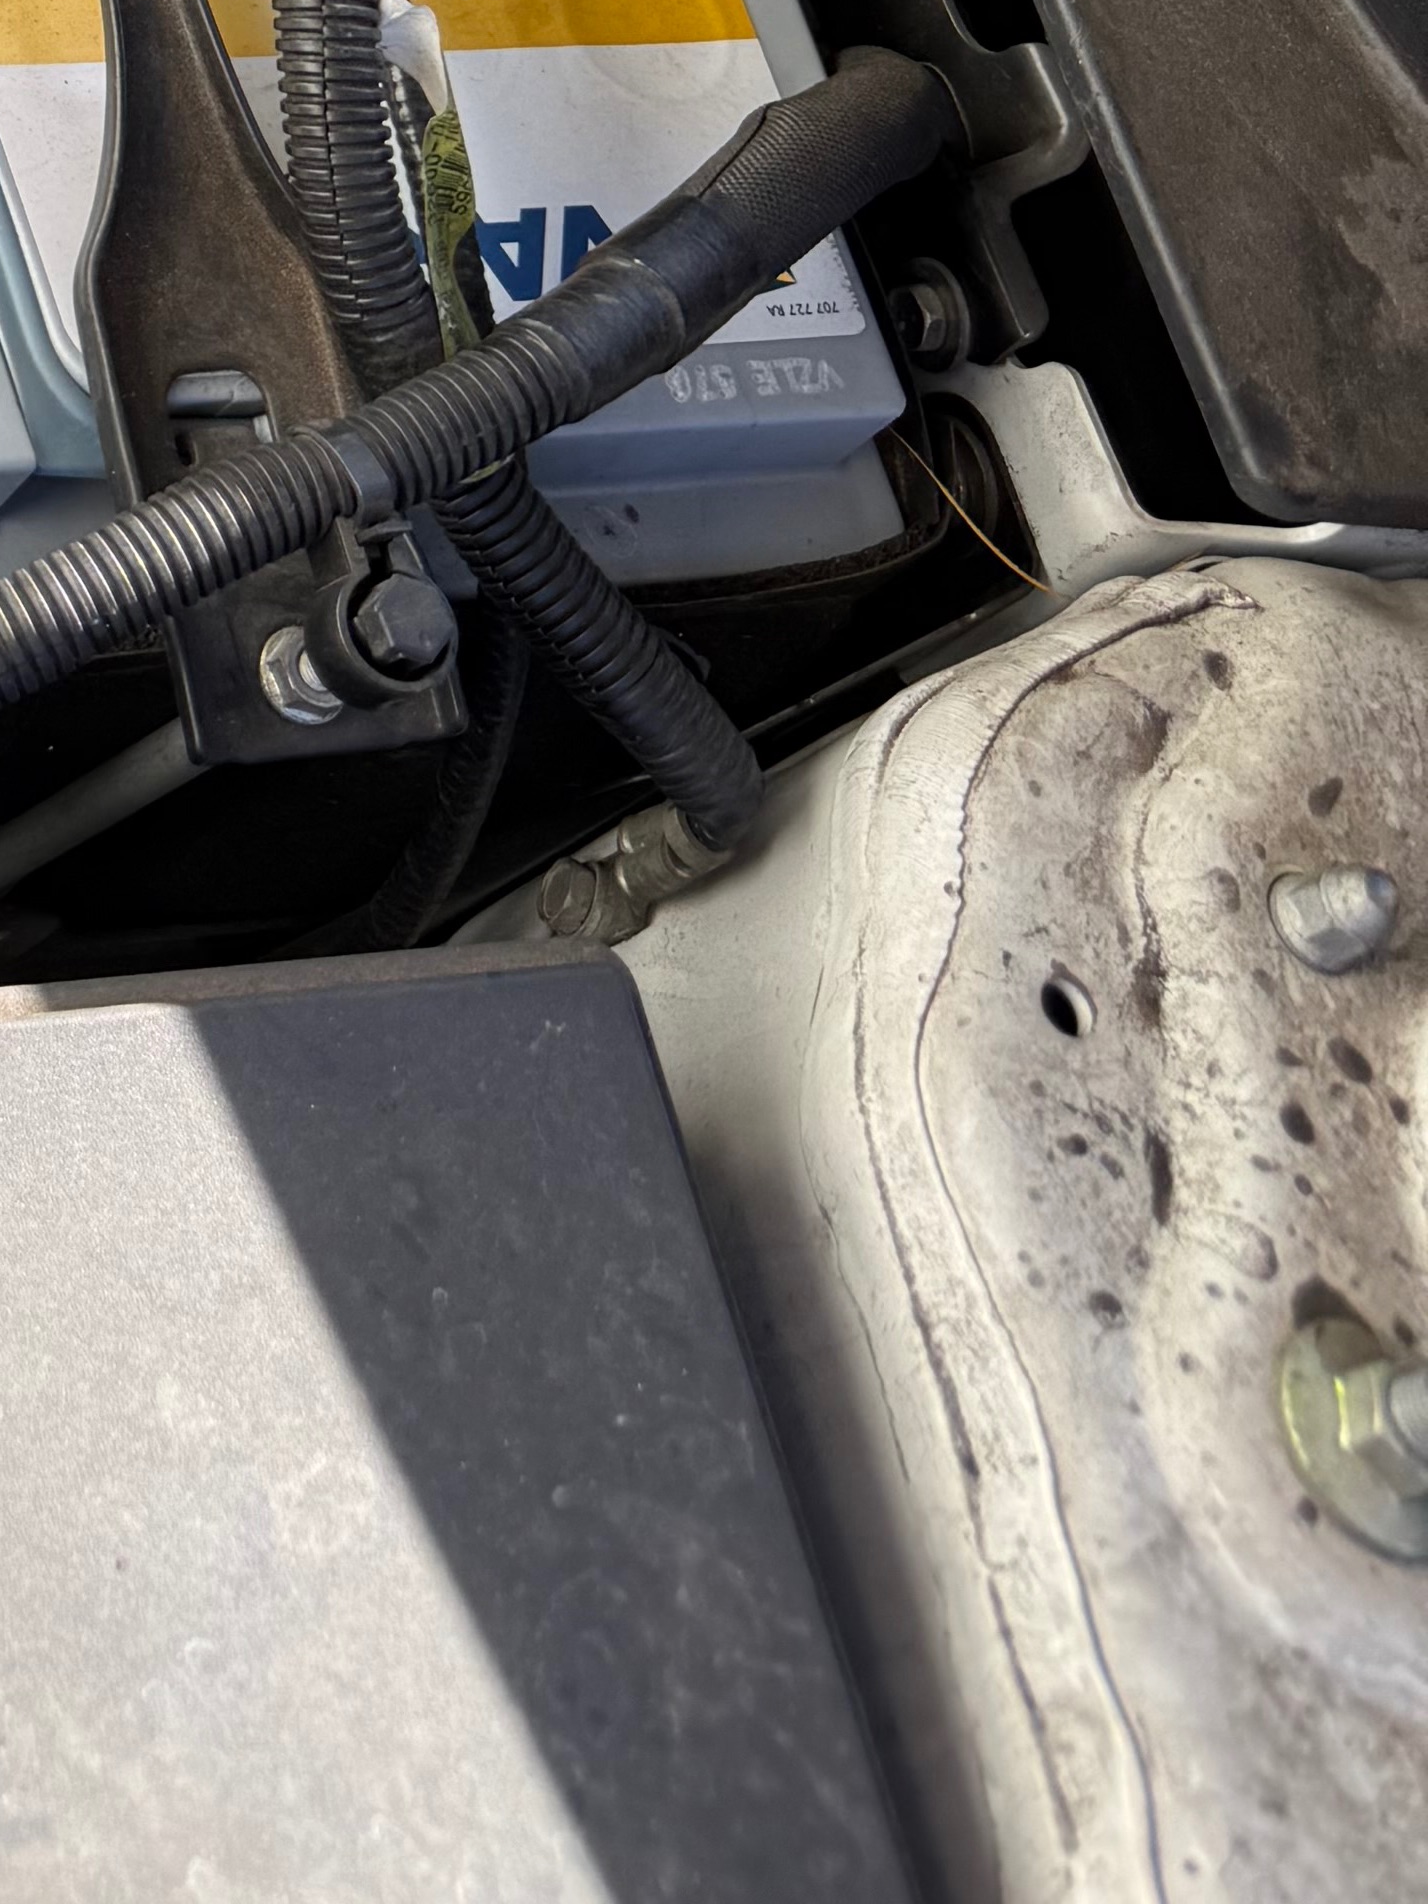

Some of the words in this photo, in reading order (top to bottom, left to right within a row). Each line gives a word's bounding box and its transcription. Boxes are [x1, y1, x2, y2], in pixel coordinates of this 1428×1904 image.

[765, 304, 785, 317] RA
[789, 303, 813, 316] 727
[817, 301, 840, 314] 707
